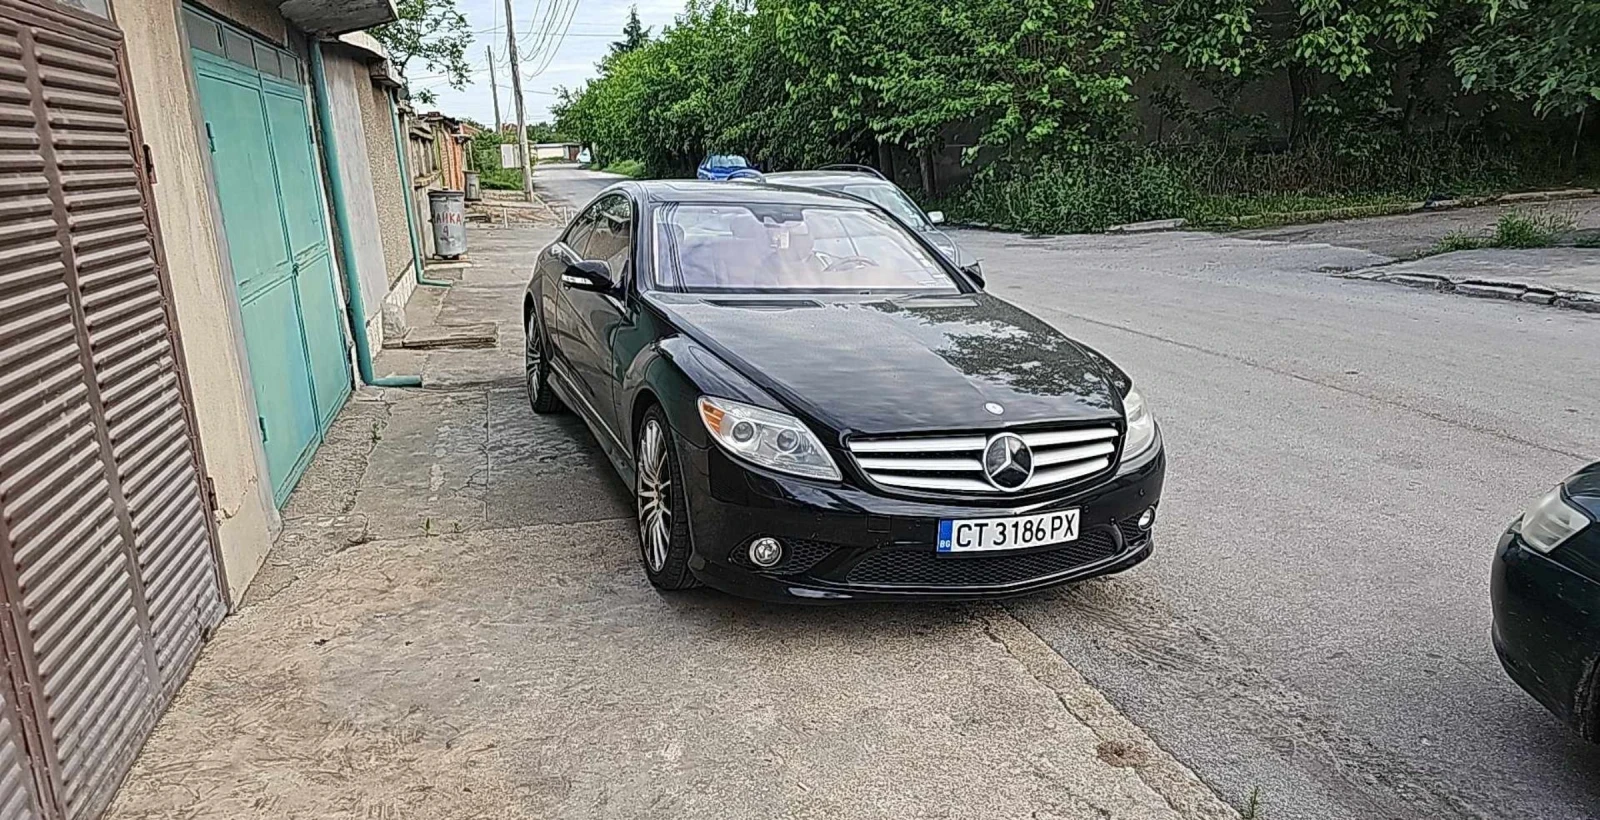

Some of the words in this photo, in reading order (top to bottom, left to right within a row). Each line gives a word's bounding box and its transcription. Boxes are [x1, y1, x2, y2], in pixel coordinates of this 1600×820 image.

[956, 523, 989, 548] CT
[993, 518, 1047, 546] 3186
[1051, 513, 1076, 540] PX
[939, 540, 951, 548] BG
